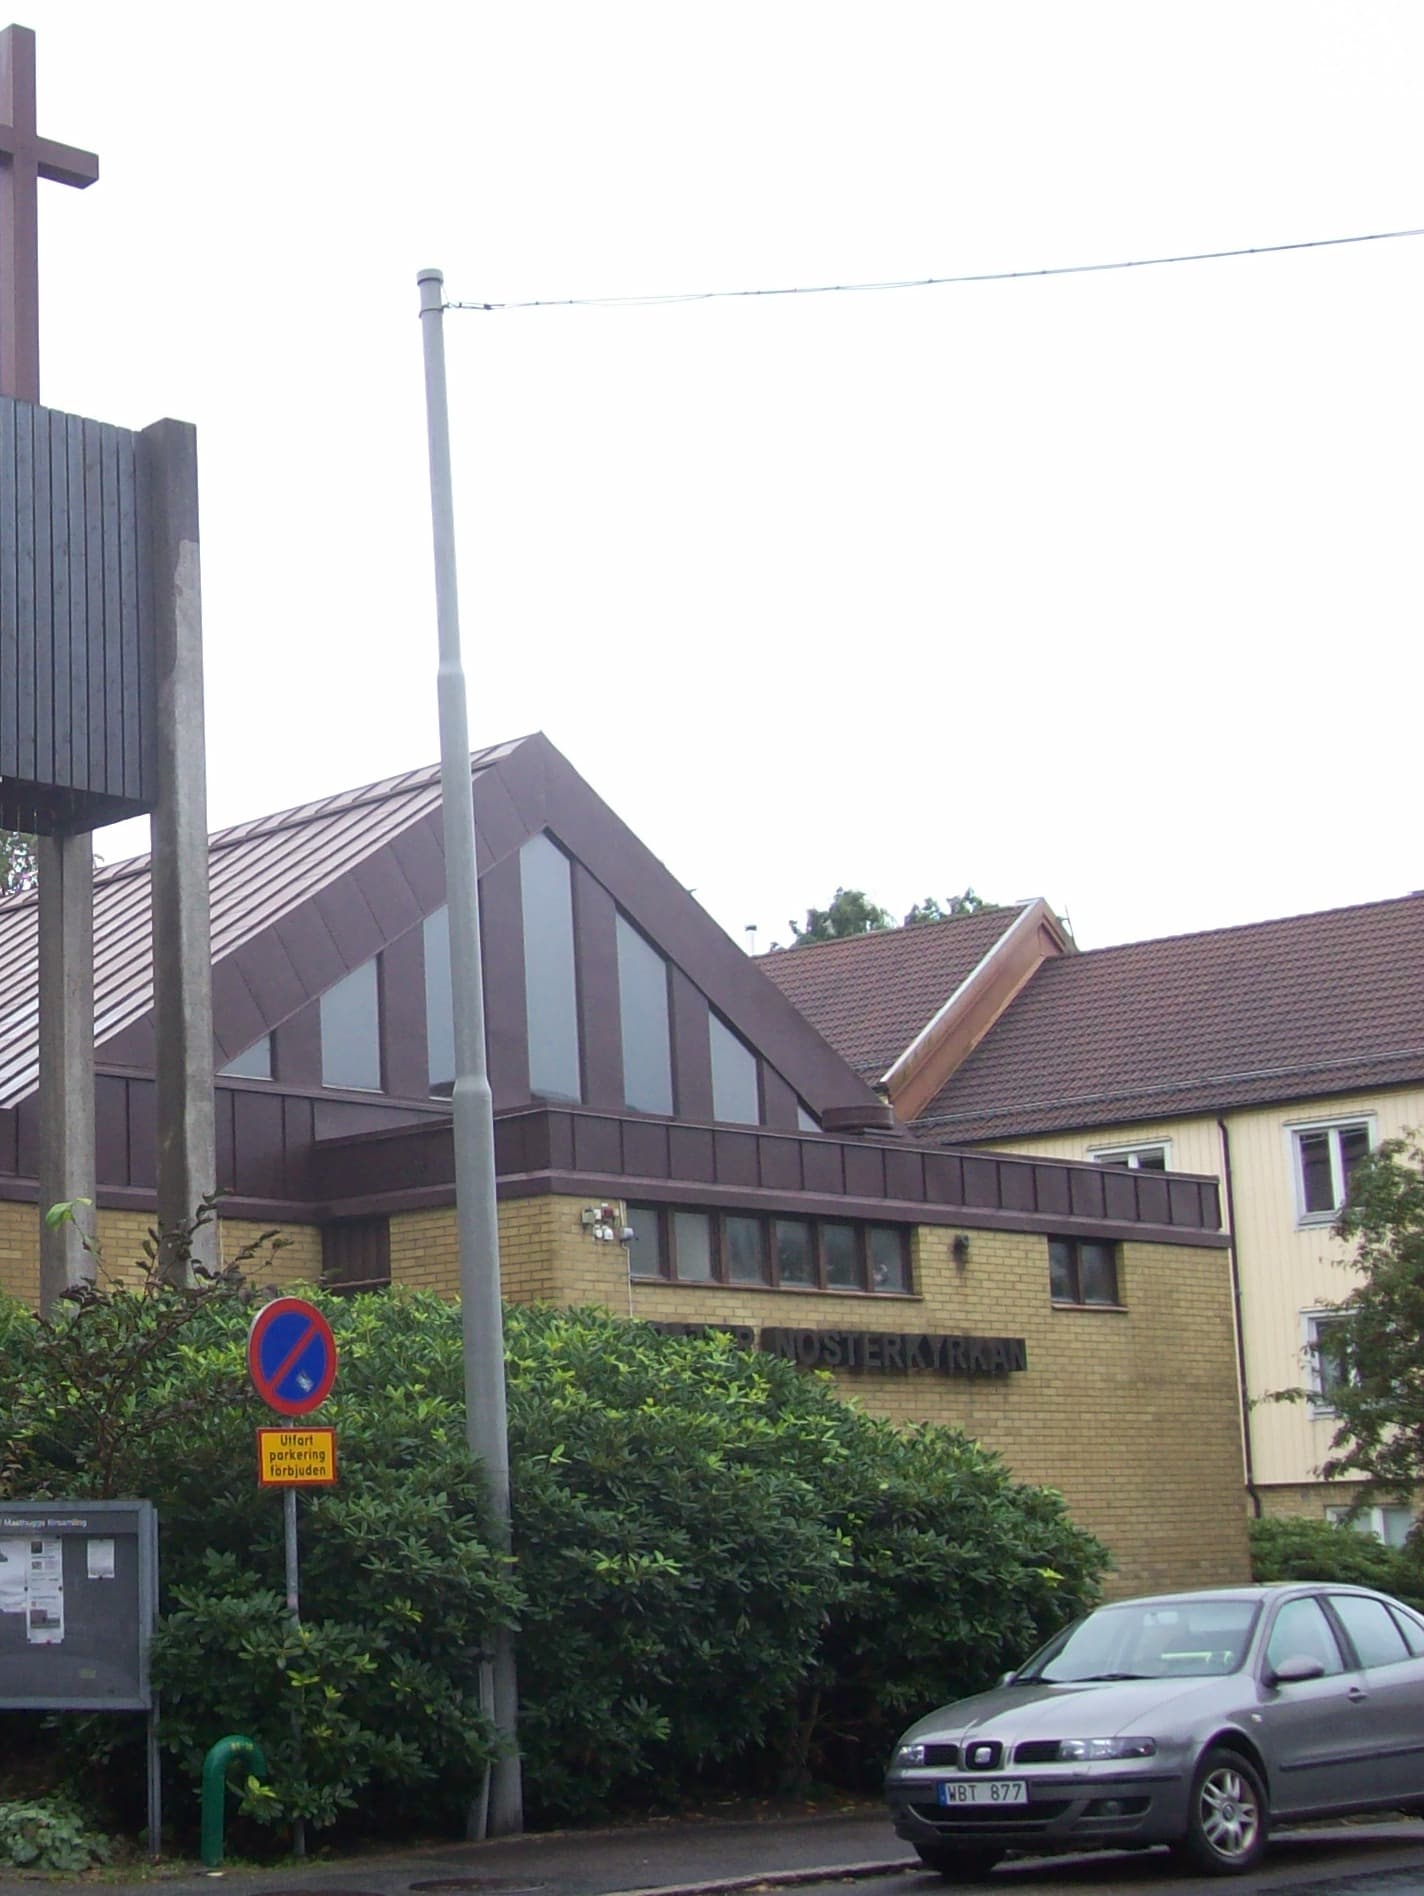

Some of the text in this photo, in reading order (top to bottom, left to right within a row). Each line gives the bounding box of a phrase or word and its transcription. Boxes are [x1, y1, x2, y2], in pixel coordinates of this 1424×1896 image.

[775, 1327, 1026, 1371] NOSTERKYRKAN
[280, 1434, 313, 1447] Utfart
[269, 1449, 325, 1463] parkering
[270, 1464, 326, 1478] förbjuden
[948, 1784, 1022, 1802] WBT 877
